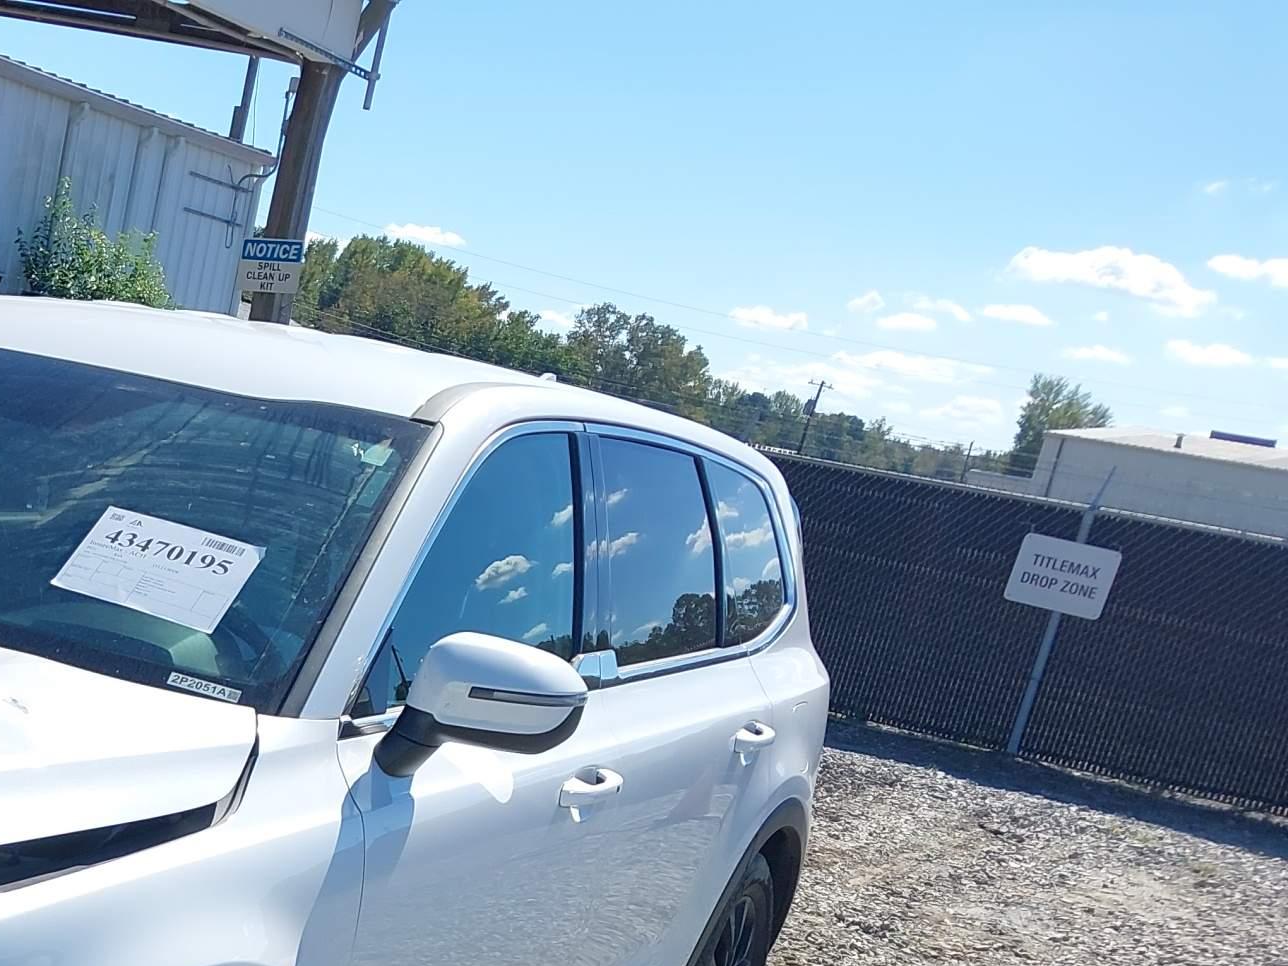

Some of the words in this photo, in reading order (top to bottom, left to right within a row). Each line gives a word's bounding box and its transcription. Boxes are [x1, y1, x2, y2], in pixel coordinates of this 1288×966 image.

[244, 242, 301, 260] NOTICE
[246, 271, 275, 281] CLEAN
[278, 273, 290, 283] UP
[257, 262, 282, 272] SPILL
[259, 282, 274, 291] KIT
[104, 529, 235, 576] 43470195
[1032, 553, 1102, 580] TITLEMAX
[1020, 571, 1058, 589] DROP
[1060, 581, 1099, 600] ZONE
[170, 674, 227, 697] 2P2051A
